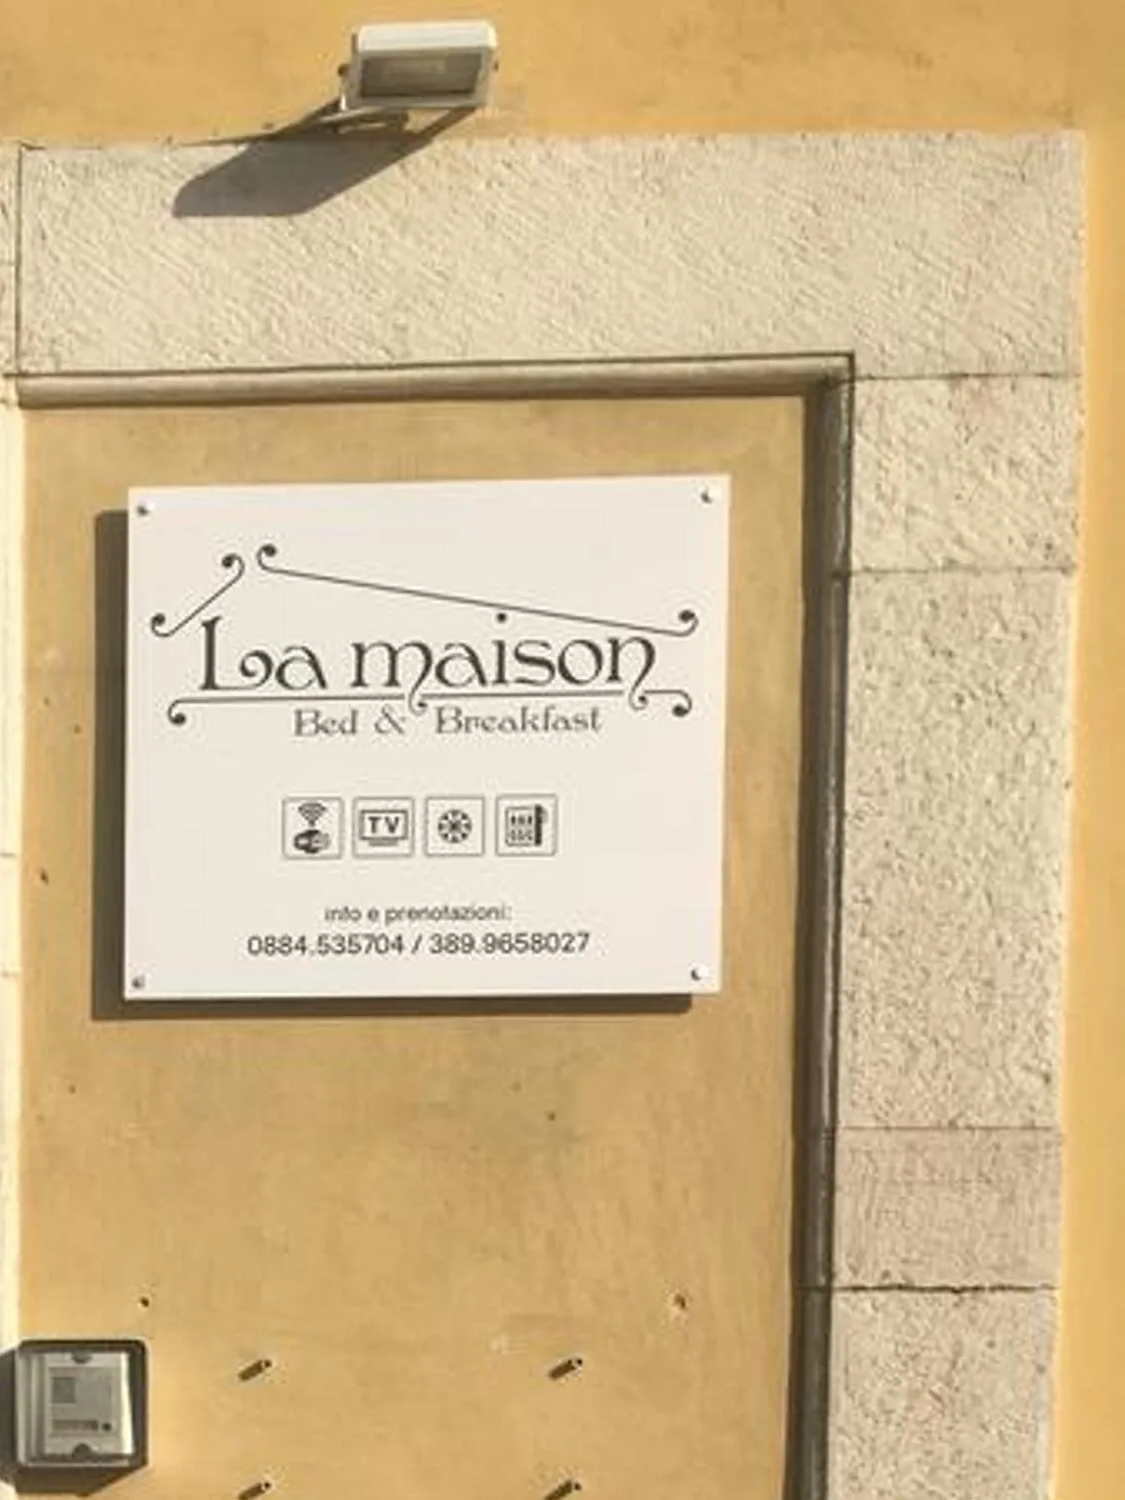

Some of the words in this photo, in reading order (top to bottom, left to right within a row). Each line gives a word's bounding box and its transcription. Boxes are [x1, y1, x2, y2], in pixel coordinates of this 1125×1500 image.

[199, 615, 327, 692] La
[349, 611, 657, 711] maison
[293, 710, 358, 737] Bed
[374, 707, 407, 736] &
[435, 706, 602, 736] Breakfast
[368, 816, 400, 834] TV
[367, 908, 380, 922] e
[384, 903, 513, 926] prenotazioni:
[247, 935, 405, 957] 0884.535704
[411, 935, 424, 956] /
[429, 932, 592, 956] 389.9658027
